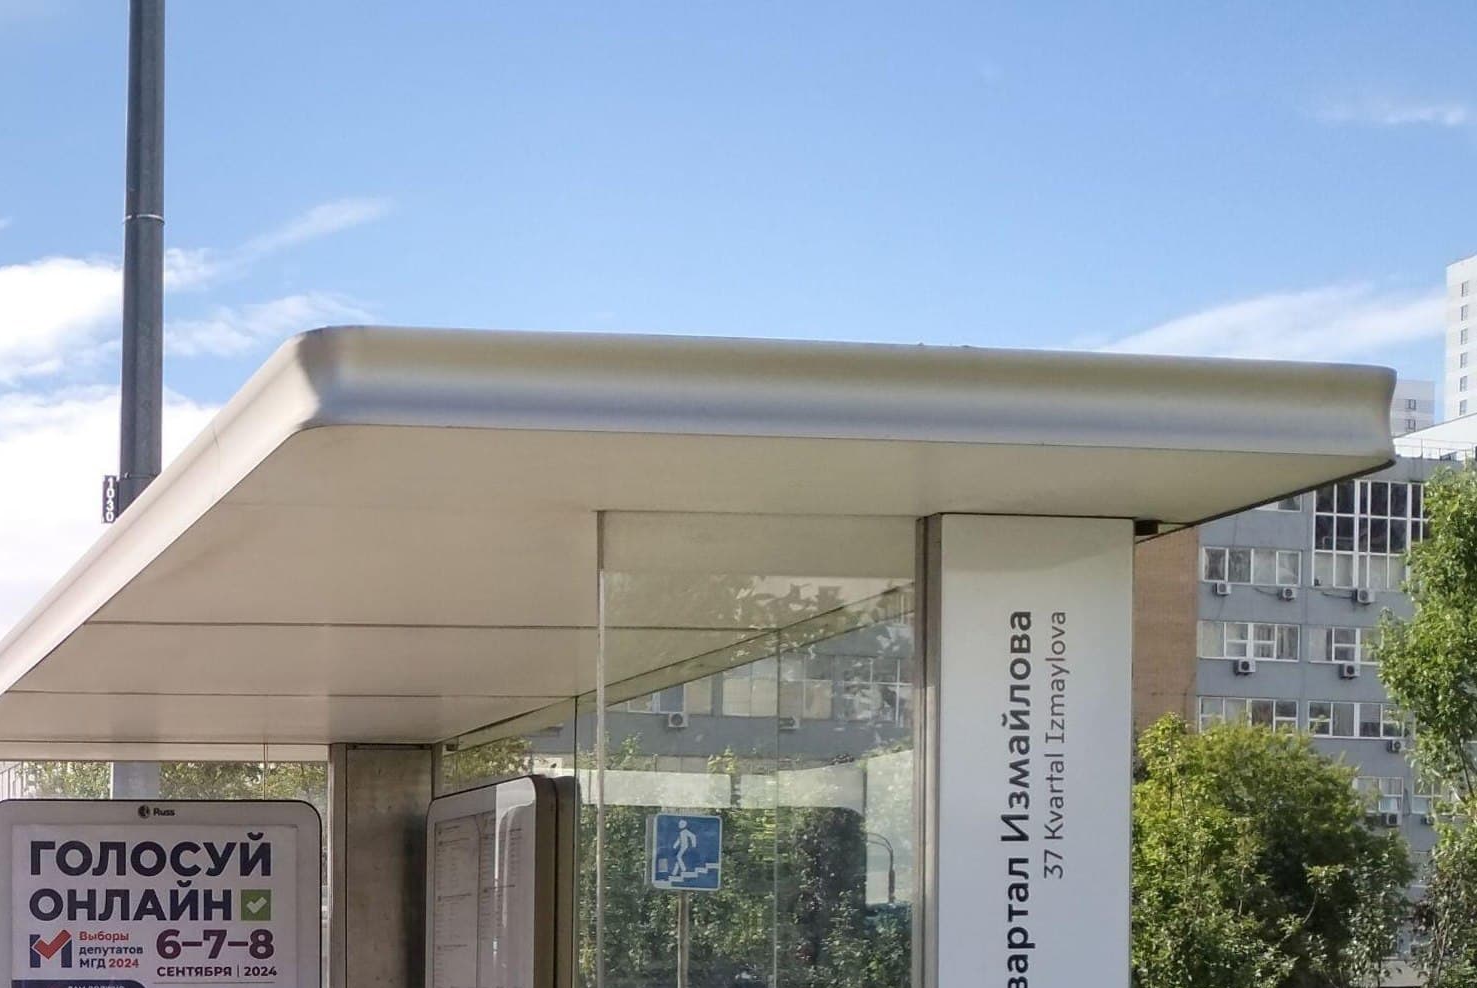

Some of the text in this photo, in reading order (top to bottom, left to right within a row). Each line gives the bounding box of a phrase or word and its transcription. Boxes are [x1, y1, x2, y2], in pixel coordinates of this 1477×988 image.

[106, 477, 115, 522] 1030
[1001, 611, 1032, 842] Измайлова
[1044, 611, 1070, 879] 37 Kvartal Izmaylova
[153, 807, 176, 816] Russ
[30, 831, 272, 877] ГОЛОСУЙ
[29, 879, 232, 922] ОНЛАЙН
[79, 931, 130, 943] Выборы
[79, 946, 144, 956] депутатов
[79, 958, 140, 969] МГД 2024
[156, 966, 277, 977] СЕНТЯБРЯ 2024
